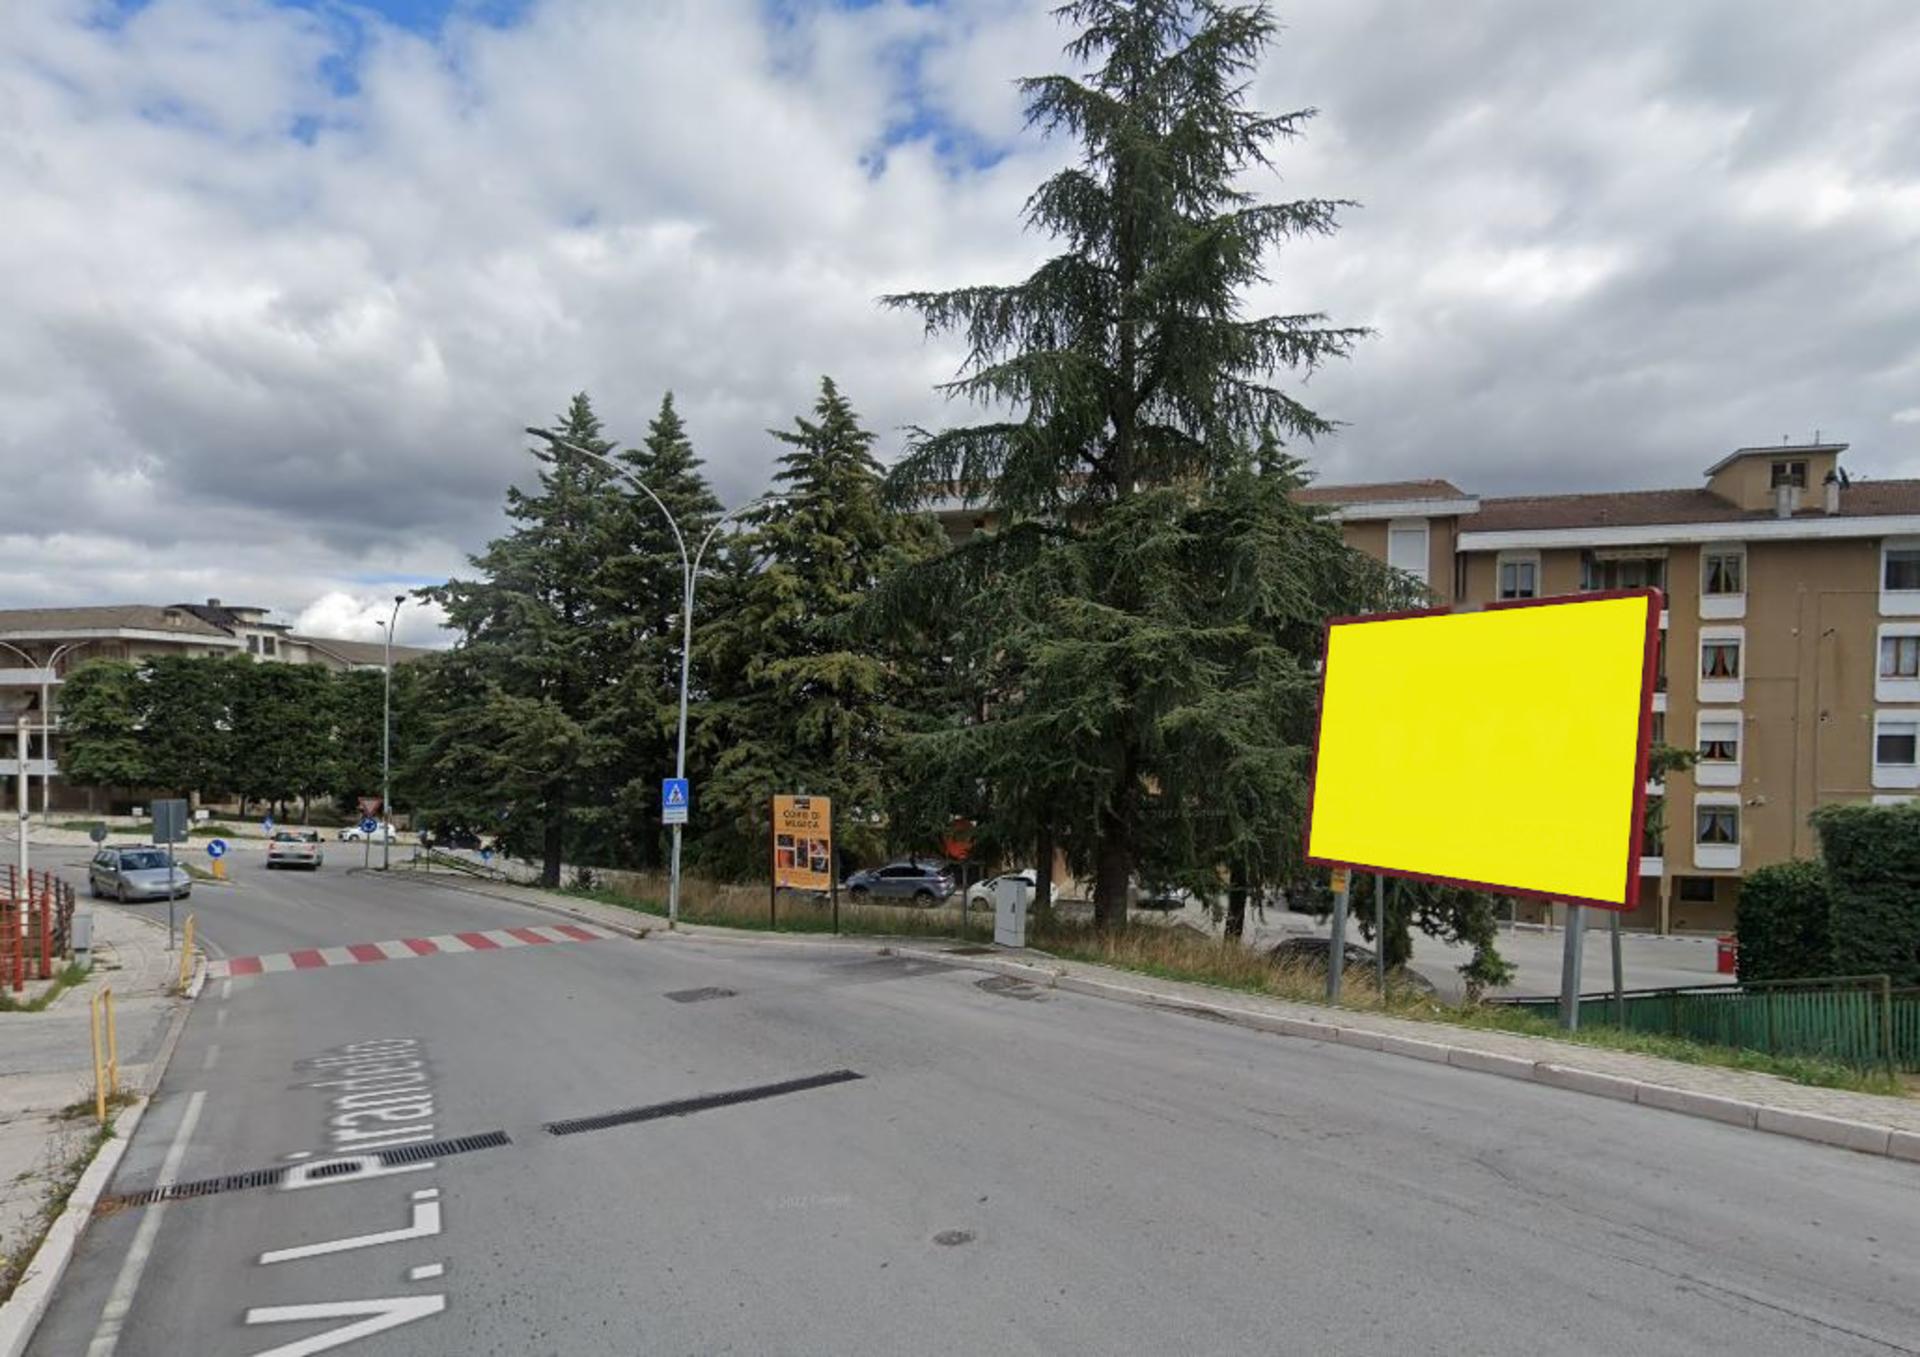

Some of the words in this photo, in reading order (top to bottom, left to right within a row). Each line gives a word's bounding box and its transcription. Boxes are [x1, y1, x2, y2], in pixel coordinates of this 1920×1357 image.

[282, 1038, 436, 1190] Pirandello
[259, 1188, 441, 1265] L.
[245, 1264, 445, 1357] V.
